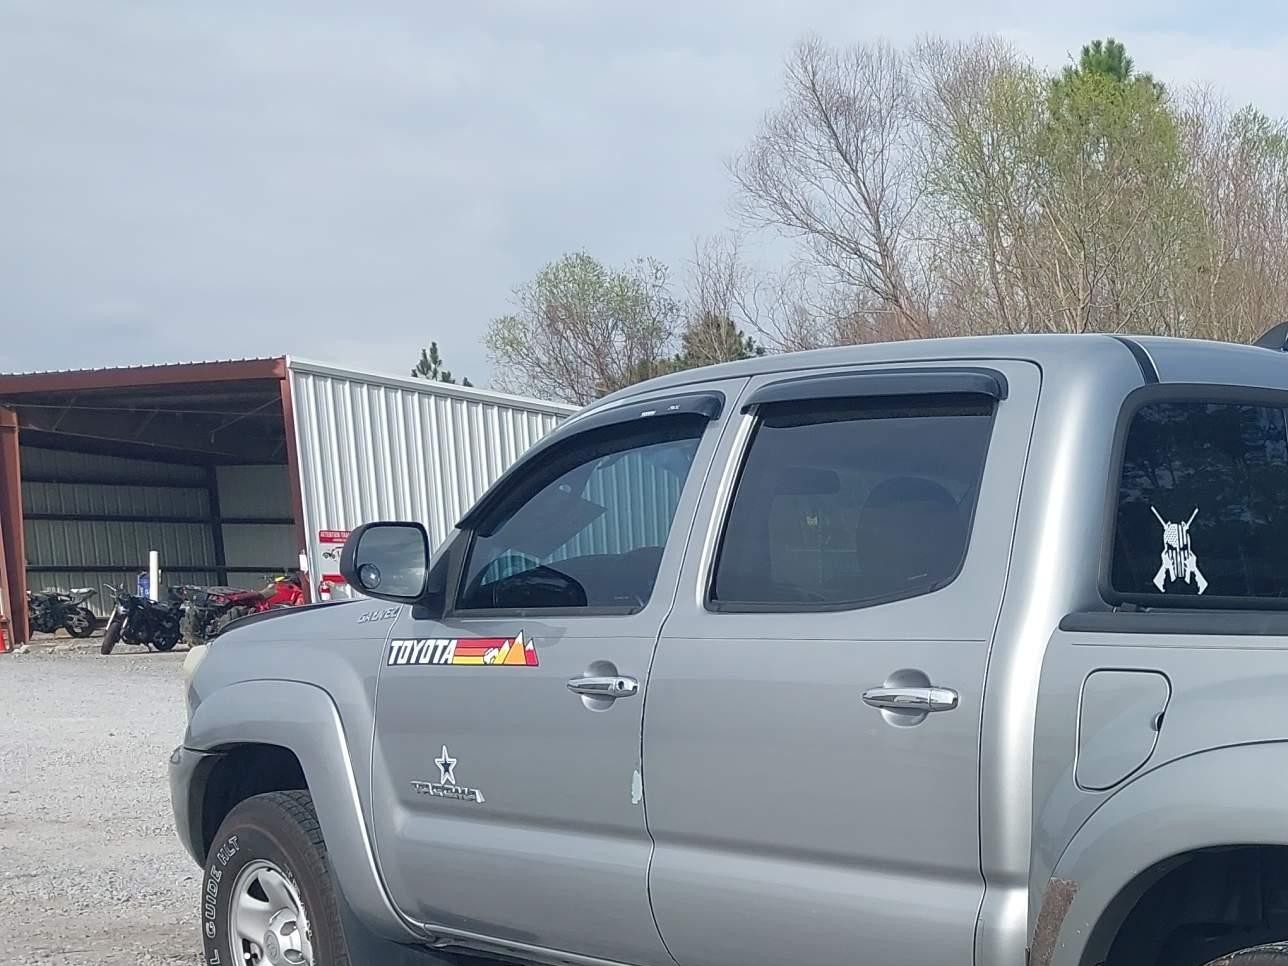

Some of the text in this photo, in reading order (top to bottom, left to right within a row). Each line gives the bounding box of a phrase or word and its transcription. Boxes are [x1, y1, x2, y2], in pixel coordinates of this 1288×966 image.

[388, 639, 458, 665] TOYOTA
[205, 865, 223, 939] GUIDE
[217, 835, 241, 868] HLT
